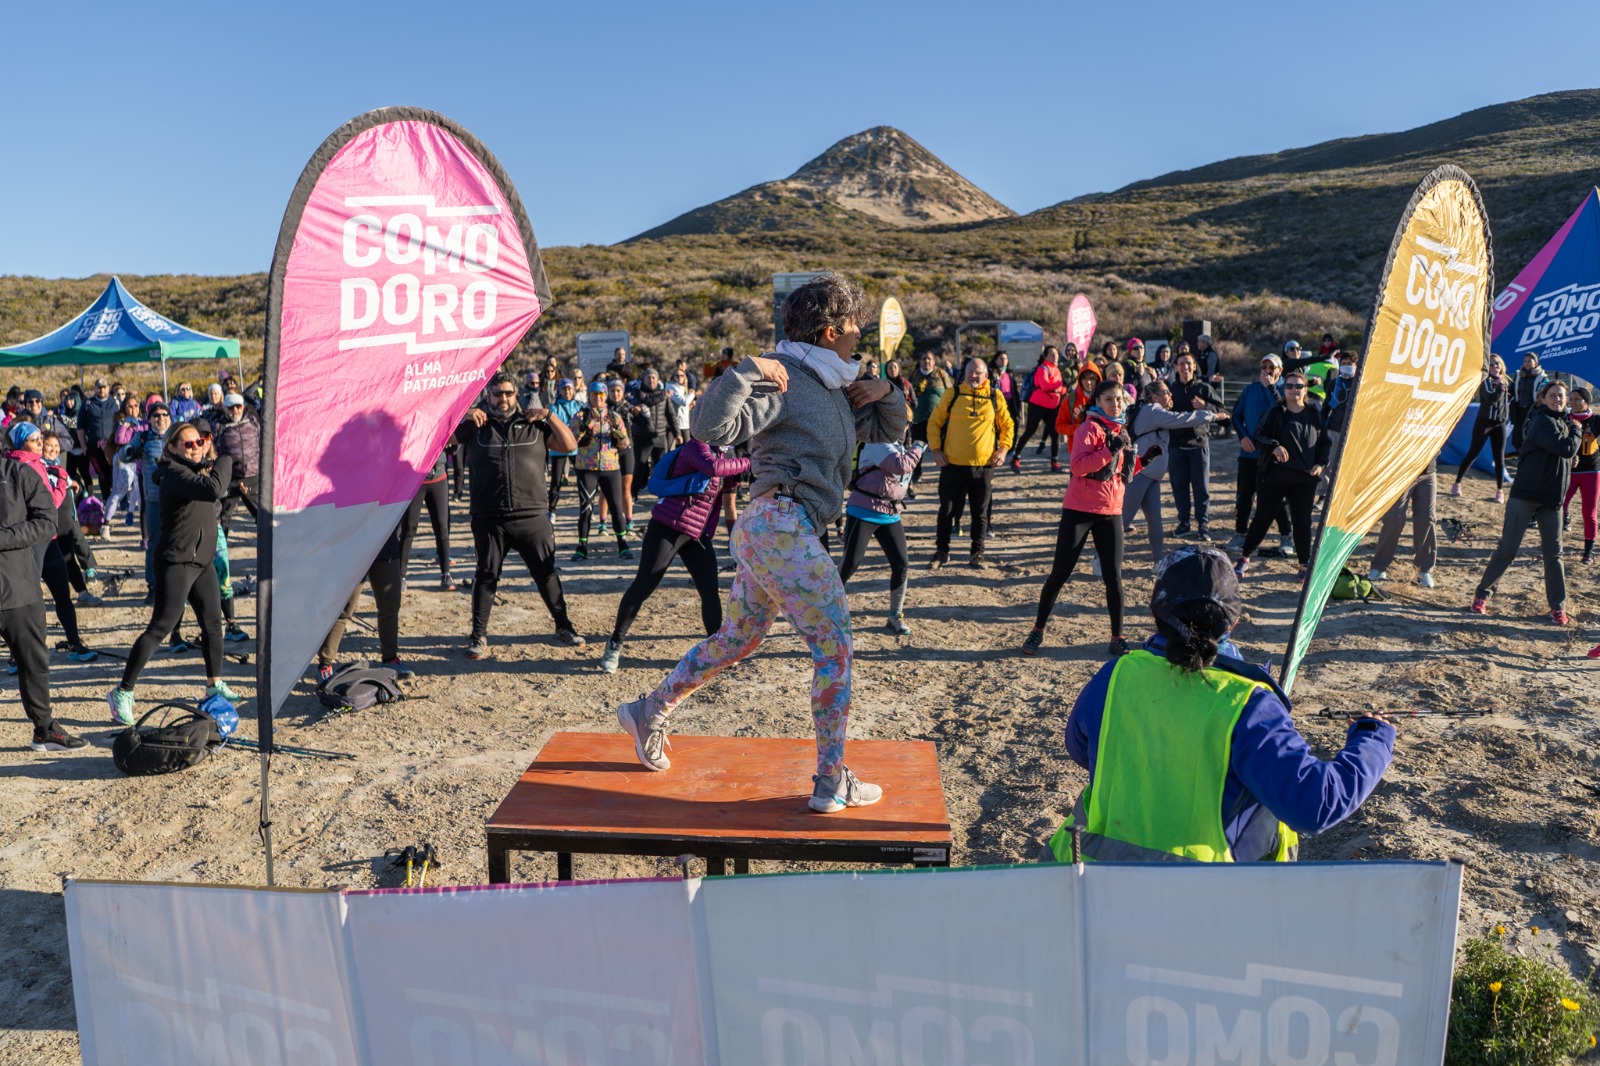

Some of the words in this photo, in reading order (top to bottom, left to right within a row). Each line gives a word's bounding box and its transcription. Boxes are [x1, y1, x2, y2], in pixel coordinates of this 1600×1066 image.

[342, 213, 498, 275] COMO
[340, 273, 498, 335] DORO
[1405, 254, 1475, 330] COMO
[1528, 290, 1600, 323] COMO
[1518, 312, 1600, 347] DORO
[1389, 313, 1467, 386] DORO
[1542, 346, 1562, 355] ALMA
[403, 369, 487, 394] PATAGÓNICA
[405, 361, 442, 377] ALMA
